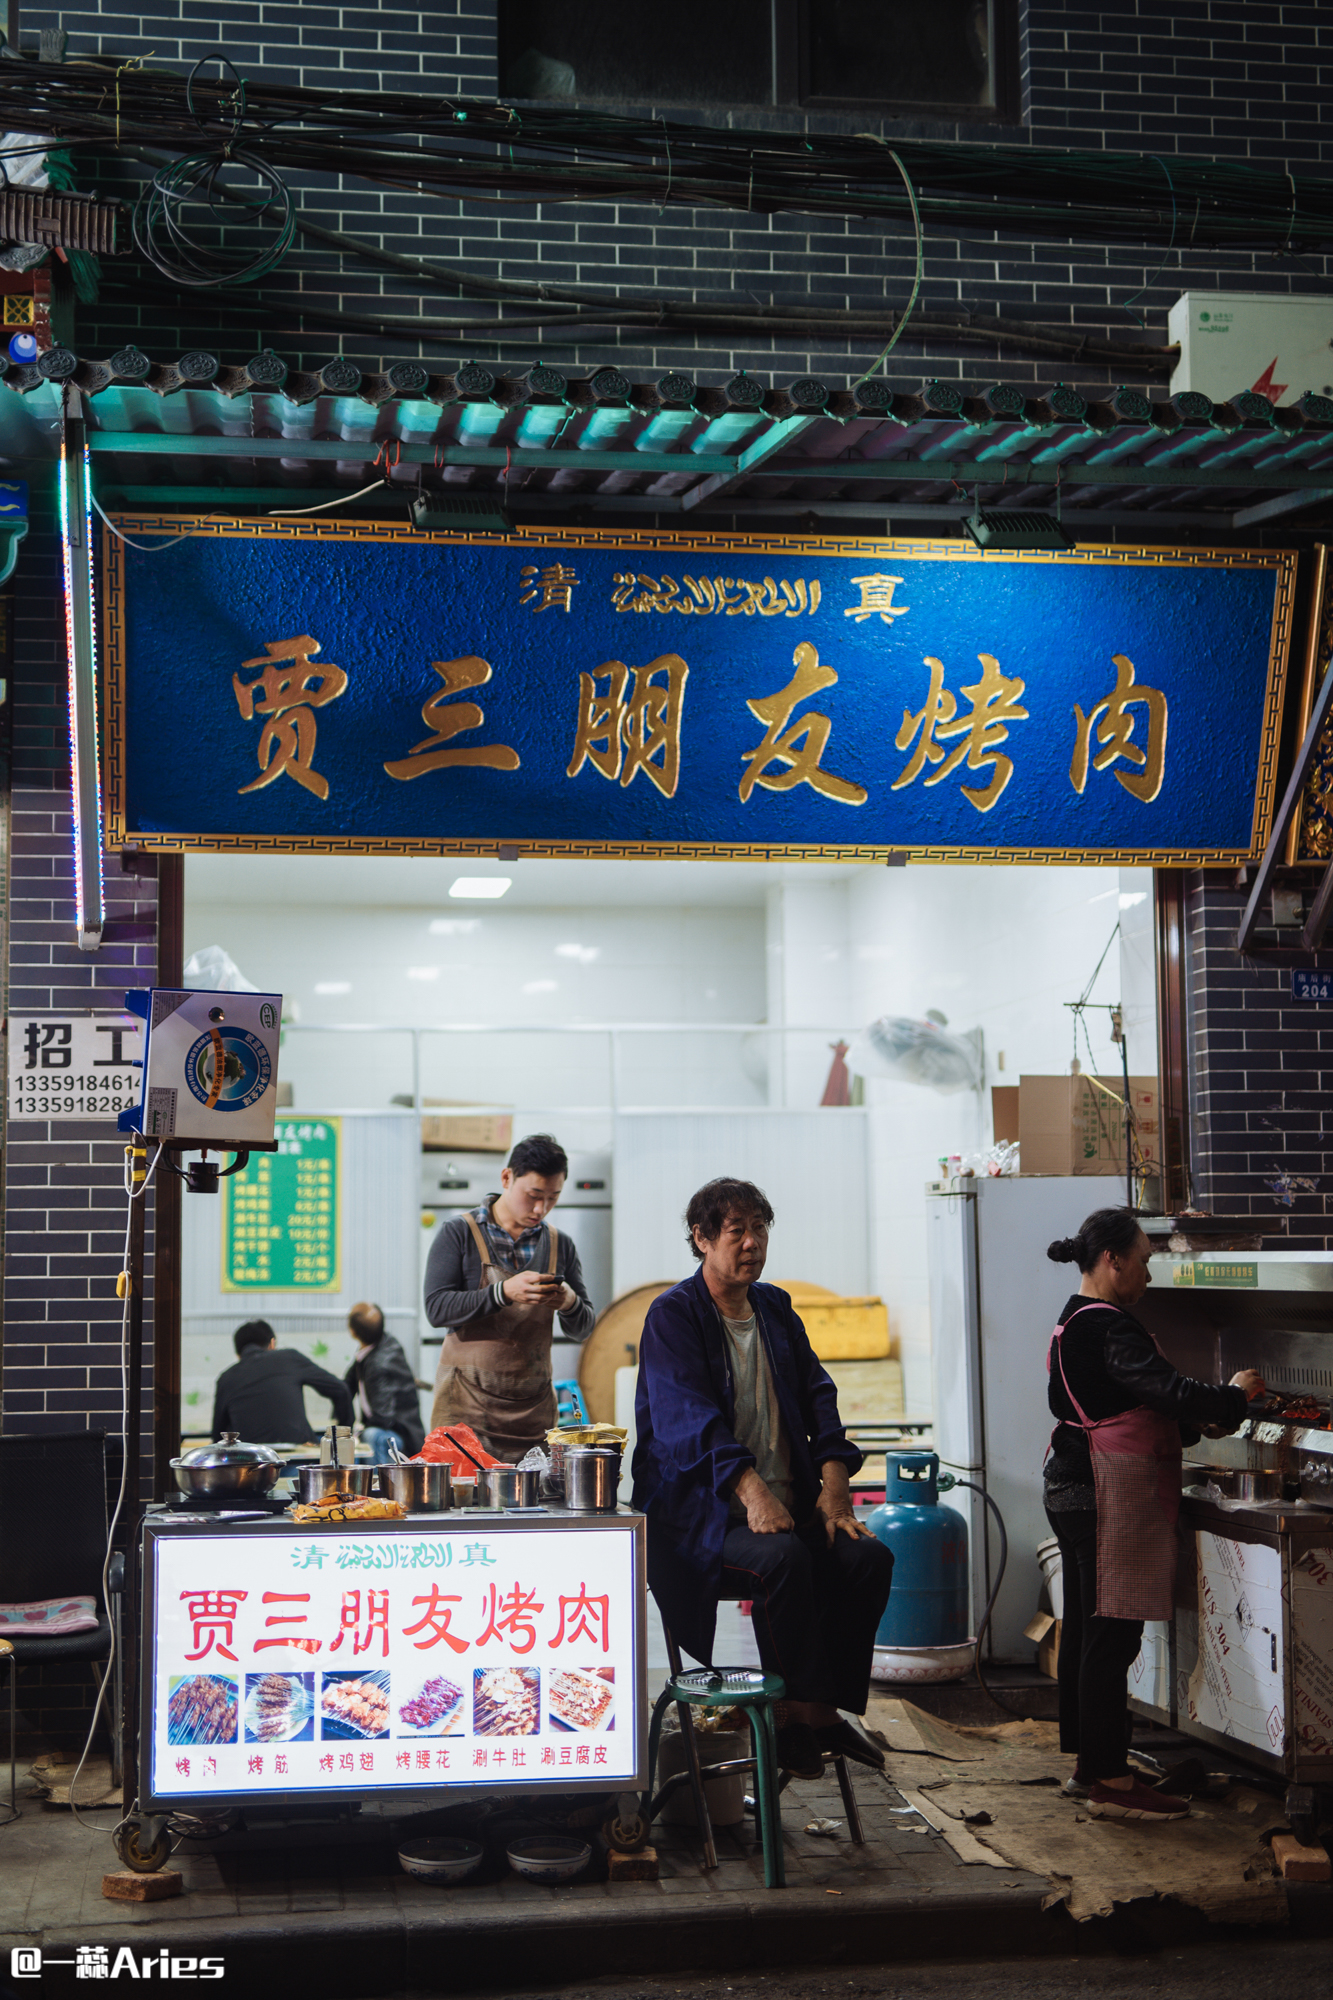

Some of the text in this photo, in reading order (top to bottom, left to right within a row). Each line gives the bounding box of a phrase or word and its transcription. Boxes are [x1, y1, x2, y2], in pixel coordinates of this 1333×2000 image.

[519, 562, 910, 624] 清 真
[232, 634, 1168, 812] 贾三朋友烤肉
[1302, 984, 1328, 998] 204
[24, 1022, 138, 1069] 招工
[290, 1543, 497, 1570] 清 真
[179, 1581, 610, 1662] 贾三朋友烤肉
[1200, 1575, 1217, 1615] SUS
[1214, 1622, 1230, 1656] 304
[247, 1753, 289, 1775] 烤筋
[318, 1752, 374, 1773] 烤鸡翅
[395, 1749, 451, 1770] 烤腰花
[472, 1747, 527, 1768] 涮牛肚
[540, 1744, 608, 1766] 涮豆腐皮
